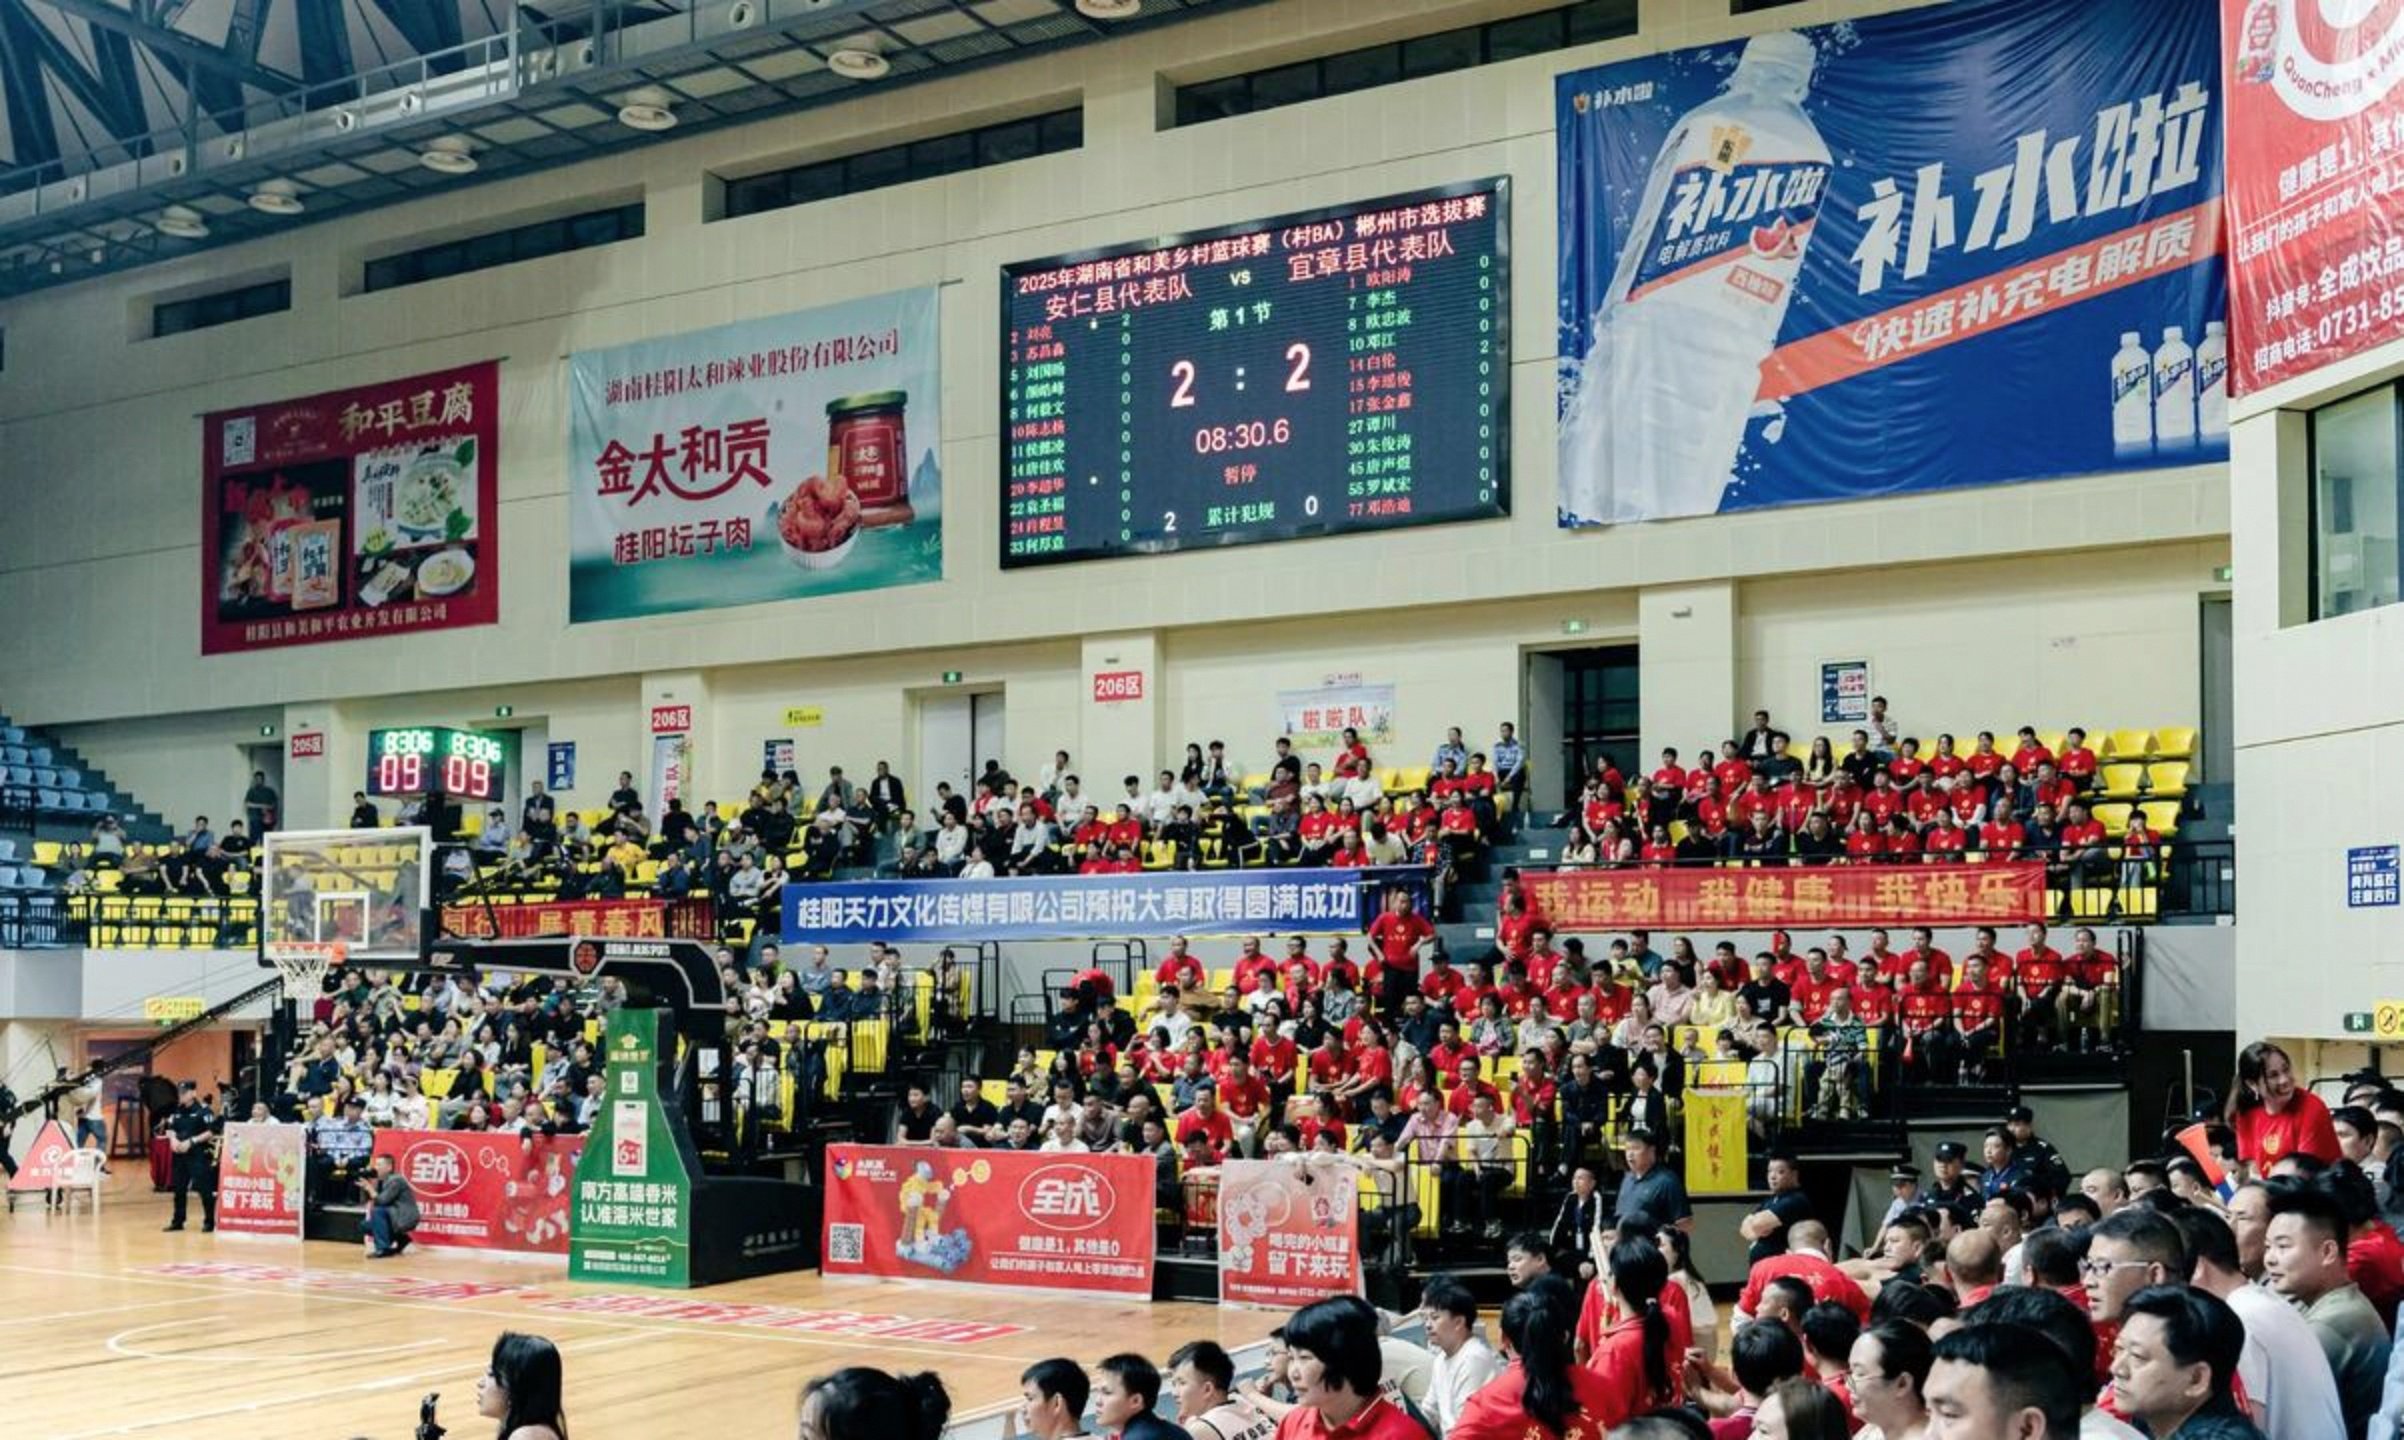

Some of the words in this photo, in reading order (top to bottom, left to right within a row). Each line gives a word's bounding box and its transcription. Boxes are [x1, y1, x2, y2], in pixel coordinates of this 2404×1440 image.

[1850, 81, 2208, 296] 补水啦
[1665, 168, 1825, 241] 补水啦
[1019, 194, 1487, 294] 2025年湖南省和美乡村篮球赛（村BA）郴州市选拔赛
[1288, 229, 1456, 283] 宜章县代表队
[1480, 255, 1489, 269] 0
[1045, 274, 1193, 321] 安仁县代表队
[1348, 297, 1357, 310] 7
[1480, 276, 1489, 290] 0
[1854, 215, 2195, 361] 快速补充电解质
[1122, 314, 1130, 326] 2
[1348, 318, 1357, 331] 8
[1480, 297, 1489, 311] 0
[1122, 332, 1130, 346] 0
[1349, 338, 1364, 351] 10
[1480, 319, 1489, 333] 0
[605, 329, 899, 406] 湖南桂阳太和辣业股份有限公司
[1010, 369, 1018, 381] 5
[1122, 352, 1130, 365] 0
[1349, 358, 1363, 372] 14
[1480, 339, 1489, 353] 2
[1122, 372, 1130, 385] 0
[1171, 360, 1196, 408] 2
[1286, 343, 1312, 392] 2
[1349, 379, 1364, 392] 15
[1480, 361, 1489, 375] 0
[339, 381, 473, 441] 和平豆腐
[1122, 391, 1130, 404] 0
[1350, 400, 1364, 413] 17
[1480, 382, 1489, 396] 0
[1012, 426, 1024, 439] 10
[1122, 411, 1130, 424] 0
[1348, 420, 1364, 434] 27
[1480, 403, 1489, 417] 0
[1012, 445, 1023, 458] 11
[1122, 431, 1130, 444] 0
[1196, 418, 1290, 454] 08:30.6
[1348, 441, 1364, 455] 30
[1480, 425, 1489, 439] 0
[595, 418, 772, 508] 金太和贡
[1012, 465, 1024, 477] 14
[1122, 450, 1130, 463] 0
[1224, 463, 1257, 486] 暂停
[1348, 462, 1364, 476] 45
[1480, 446, 1489, 460] 0
[1011, 484, 1024, 496] 20
[1122, 470, 1130, 483] 0
[1348, 482, 1364, 496] 55
[1480, 467, 1489, 481] 0
[1480, 489, 1489, 503] 0
[1011, 504, 1024, 516] 22
[1122, 489, 1130, 502] 0
[1122, 509, 1130, 522] 0
[1164, 512, 1177, 531] 2
[1207, 502, 1275, 528] 累计犯规
[1305, 495, 1318, 516] 0
[614, 517, 752, 566] 桂阳坛子肉
[1010, 541, 1024, 554] 33
[1122, 528, 1130, 541] 0
[1097, 674, 1140, 697] 206区
[653, 709, 689, 728] 206区
[1303, 706, 1367, 729] 啦啦队
[380, 753, 421, 792] 09
[447, 755, 490, 796] 09
[798, 882, 1356, 930] 桂阳天力文化传媒有限公司预祝大赛取得圆满成功
[1536, 879, 1660, 918] 我运动
[1698, 876, 1833, 916] 我健康
[1875, 872, 2019, 914] 我快乐
[581, 1180, 678, 1204] 南方高端香米
[1268, 1251, 1350, 1279] 留下来玩
